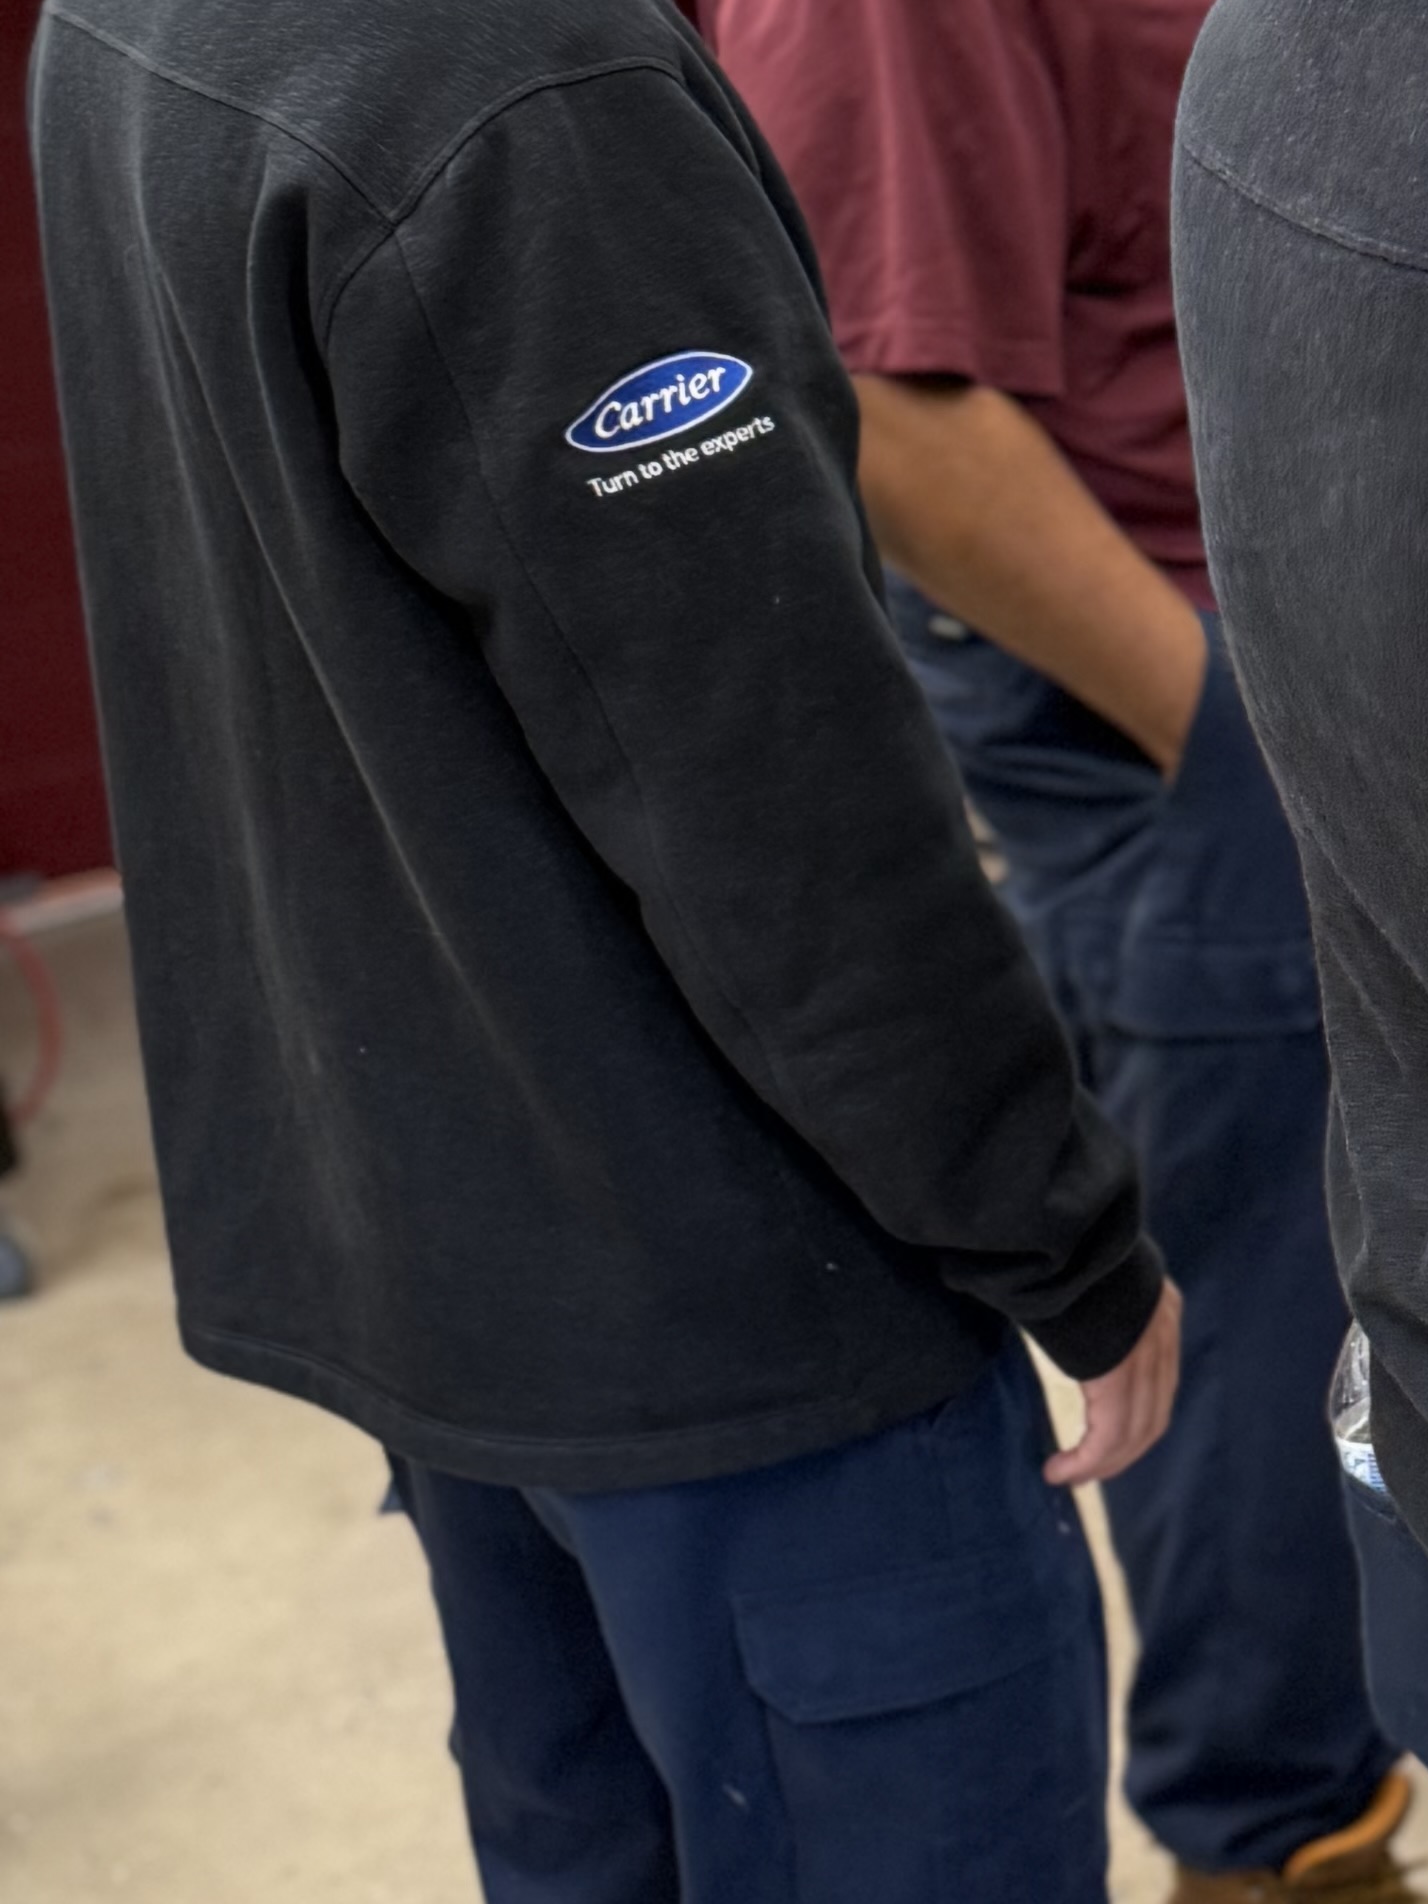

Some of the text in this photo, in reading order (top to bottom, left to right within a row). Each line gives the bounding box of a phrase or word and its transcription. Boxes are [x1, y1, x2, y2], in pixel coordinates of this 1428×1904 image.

[595, 366, 727, 439] Carrier
[587, 416, 776, 497] Turn to the experts
